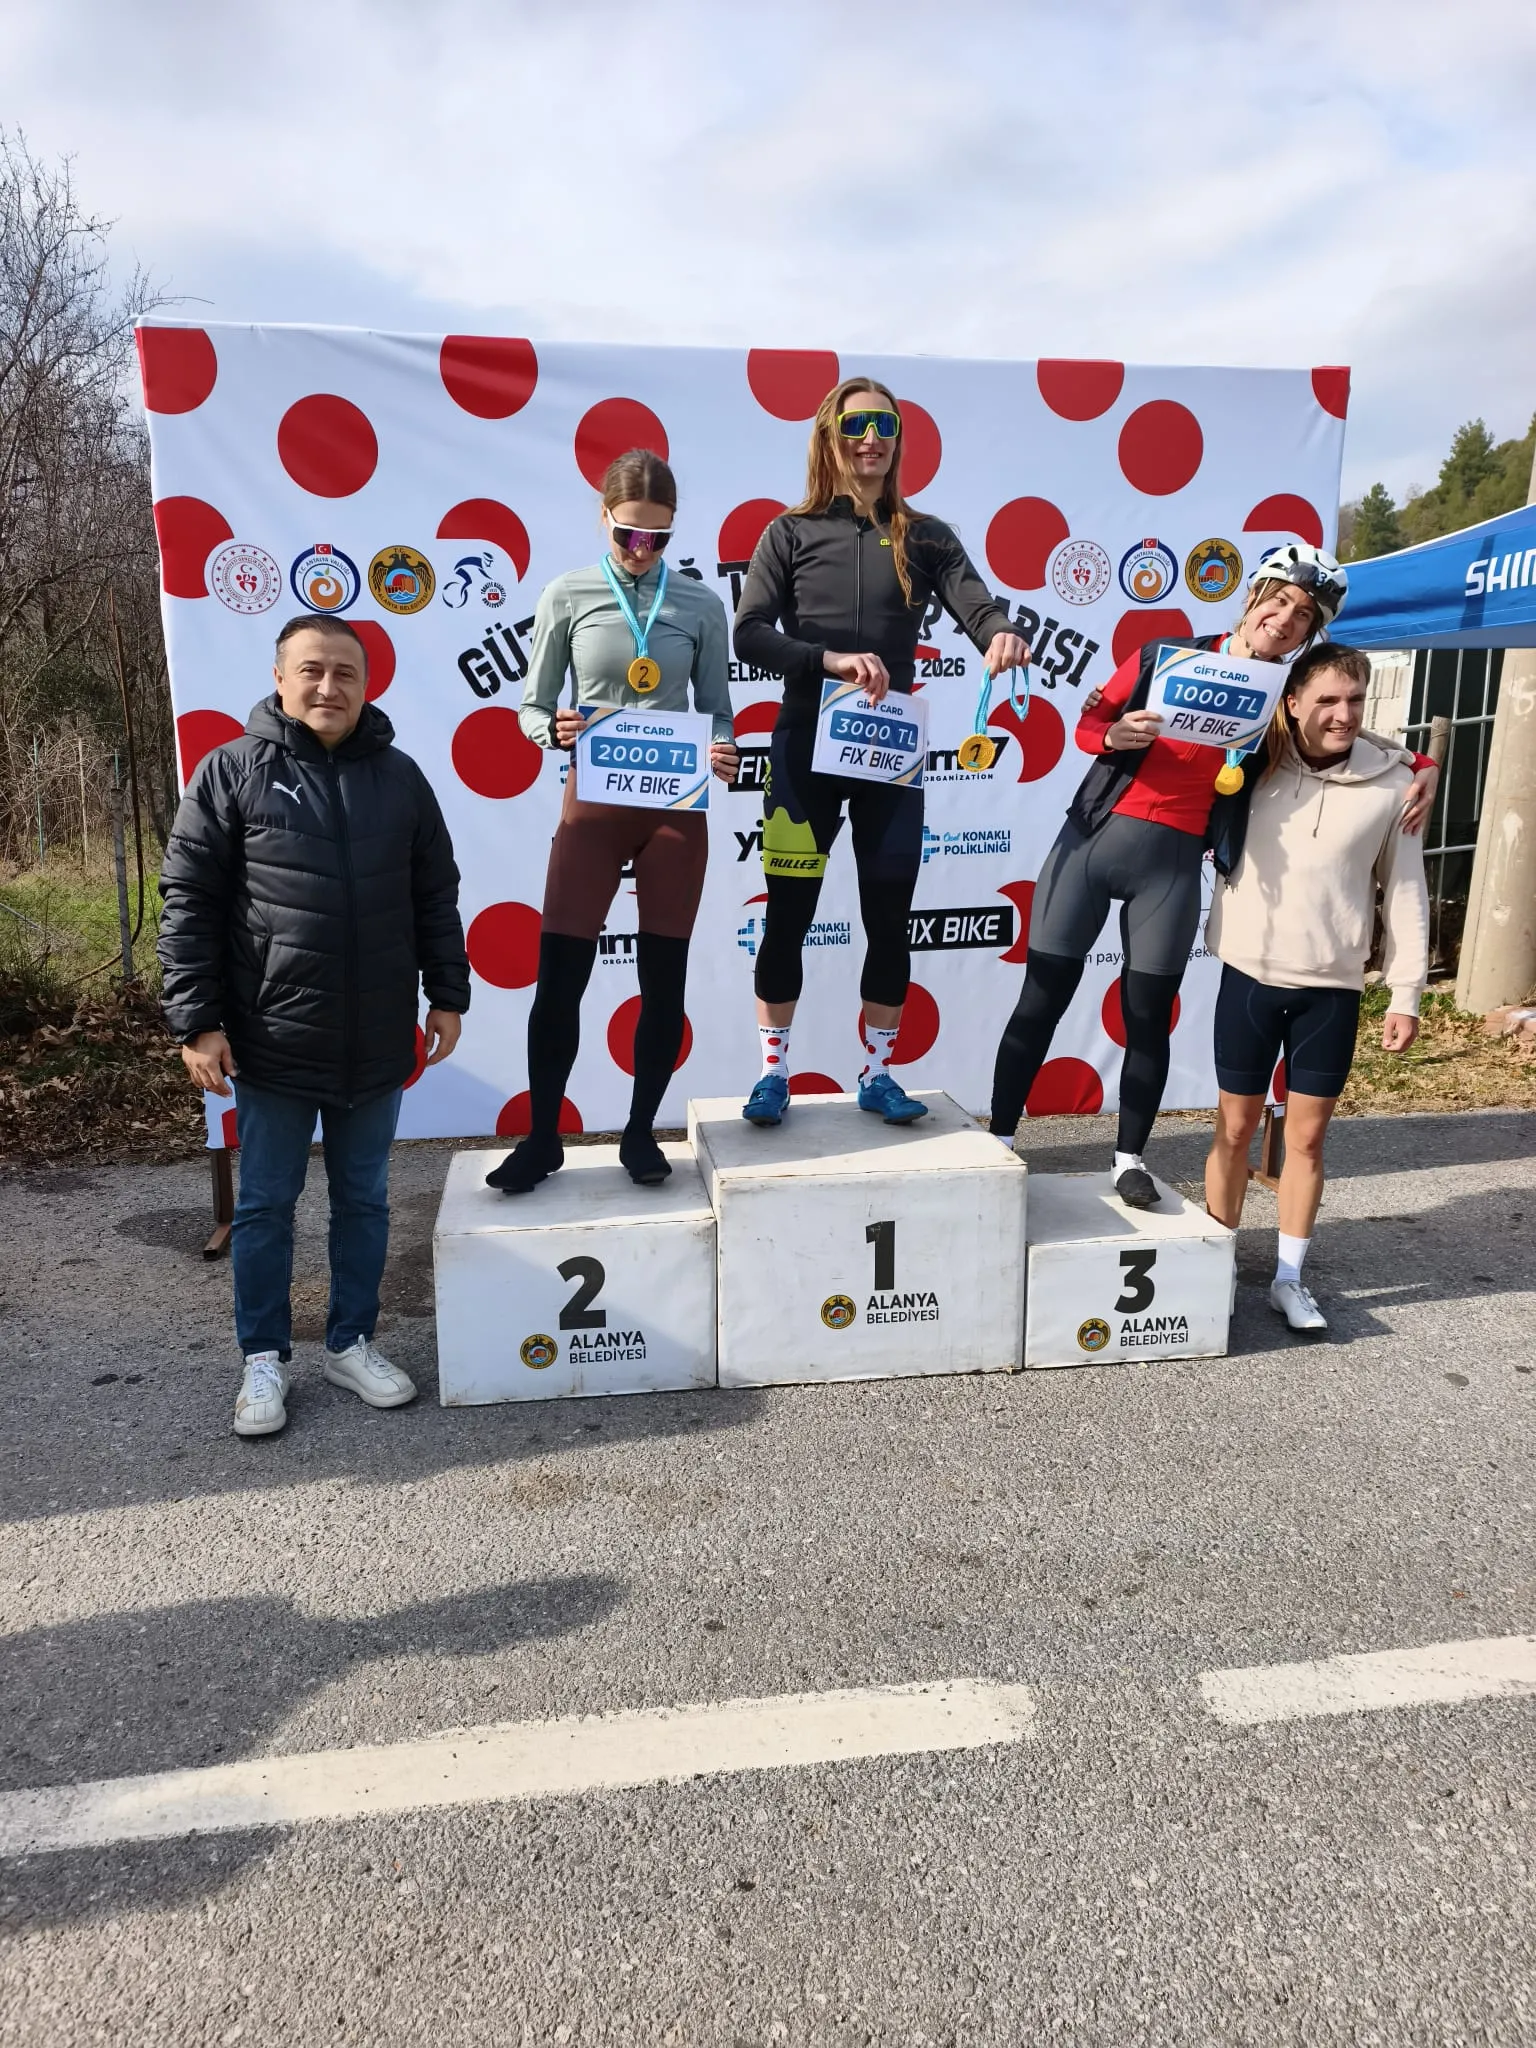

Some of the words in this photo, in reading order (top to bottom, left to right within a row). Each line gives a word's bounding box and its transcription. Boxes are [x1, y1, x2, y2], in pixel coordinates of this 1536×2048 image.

[921, 657, 966, 678] 2026
[1220, 671, 1250, 683] CARD
[1174, 684, 1228, 707] 1000
[1236, 695, 1258, 713] TL
[880, 704, 904, 716] CARD
[642, 726, 674, 736] CARD
[836, 718, 891, 740] 3000
[898, 728, 916, 746] TL
[1170, 713, 1201, 731] FIX
[1199, 718, 1240, 737] BIKE
[597, 744, 659, 764] 2000
[669, 749, 695, 767] TL
[839, 746, 868, 766] FIX
[869, 750, 905, 772] BIKE
[606, 773, 635, 792] FIX
[639, 775, 680, 796] BIKE
[962, 830, 1011, 842] KONAKLI
[944, 840, 1011, 856] POLİKLİNİĞİ
[942, 915, 1001, 943] BIKE
[866, 1220, 895, 1290] 1
[1114, 1249, 1157, 1314] 3
[556, 1256, 606, 1330] 2
[867, 1292, 939, 1310] ALANYA
[867, 1307, 939, 1324] BELEDİYESİ
[1120, 1316, 1189, 1333] ALANYA
[569, 1331, 646, 1349] ALANYA
[1120, 1330, 1189, 1347] BELEDİYESİ
[569, 1345, 646, 1364] BELEDİYESİ
